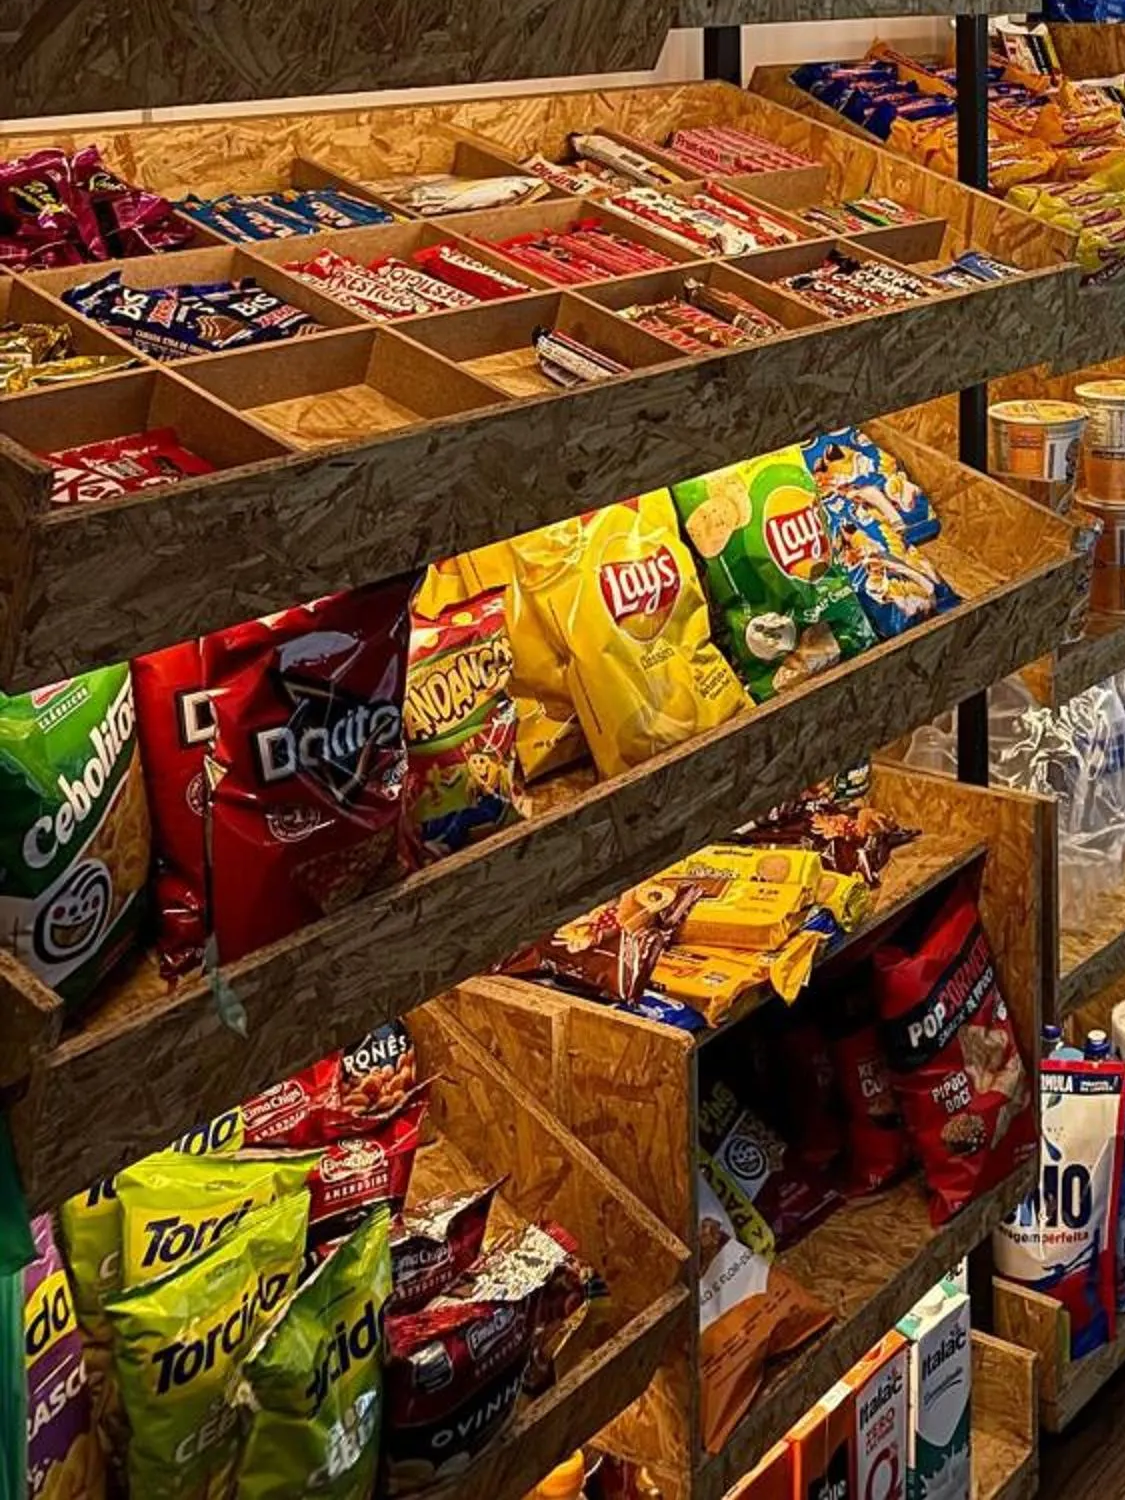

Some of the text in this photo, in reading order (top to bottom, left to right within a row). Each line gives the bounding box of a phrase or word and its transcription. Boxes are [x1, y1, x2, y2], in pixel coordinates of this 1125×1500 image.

[604, 552, 676, 618] Lay's
[256, 703, 402, 783] Dorito
[921, 1320, 967, 1381] Italac
[859, 1370, 904, 1430] Italac
